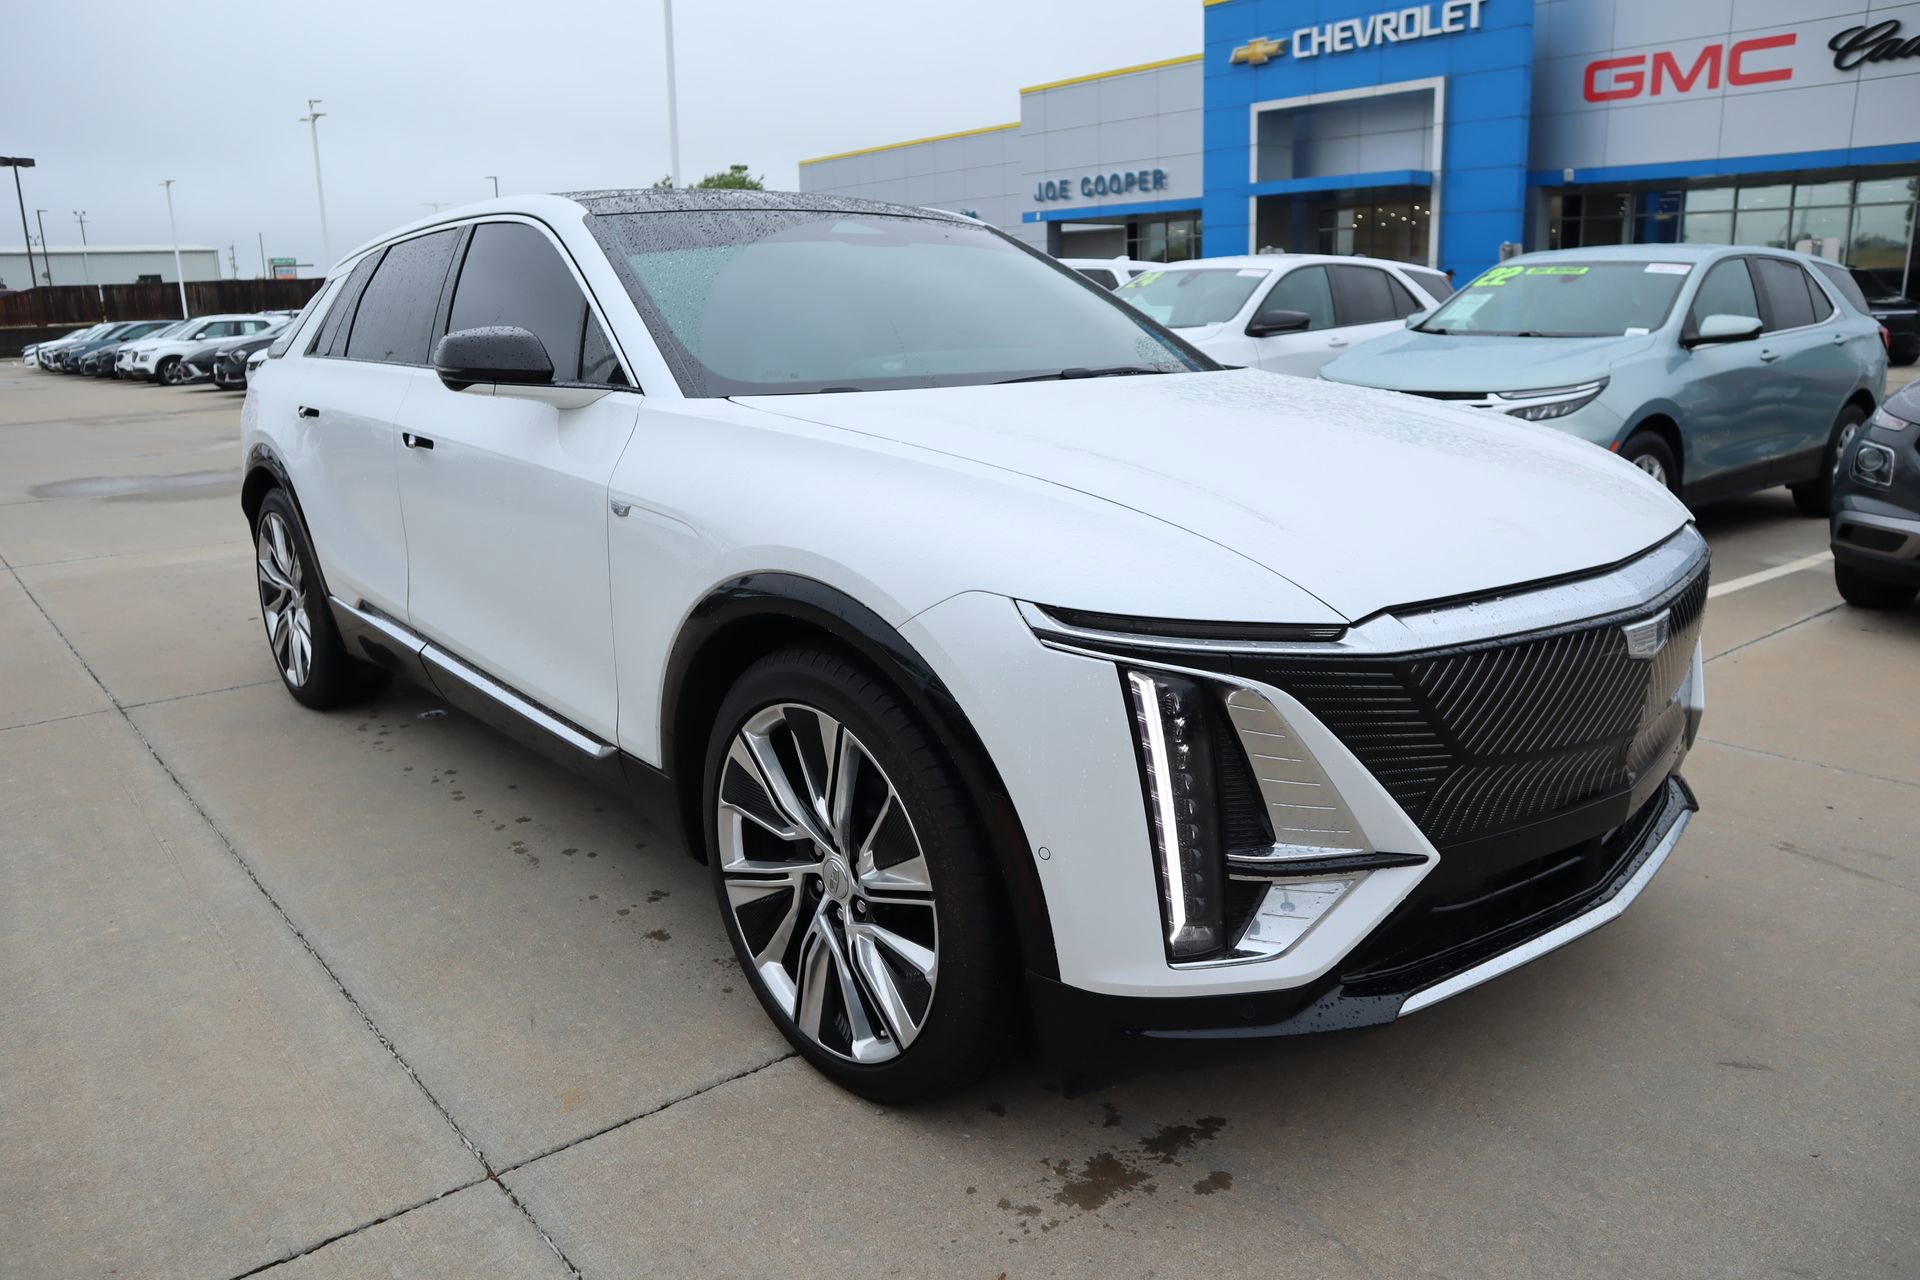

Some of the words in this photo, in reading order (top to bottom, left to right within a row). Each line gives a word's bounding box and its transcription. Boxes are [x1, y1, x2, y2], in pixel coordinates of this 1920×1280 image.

[1292, 0, 1486, 59] CHEVROLET
[1583, 33, 1797, 103] GMC
[1034, 179, 1072, 202] JOE
[1080, 169, 1167, 197] COOPER
[1472, 266, 1524, 287] 22
